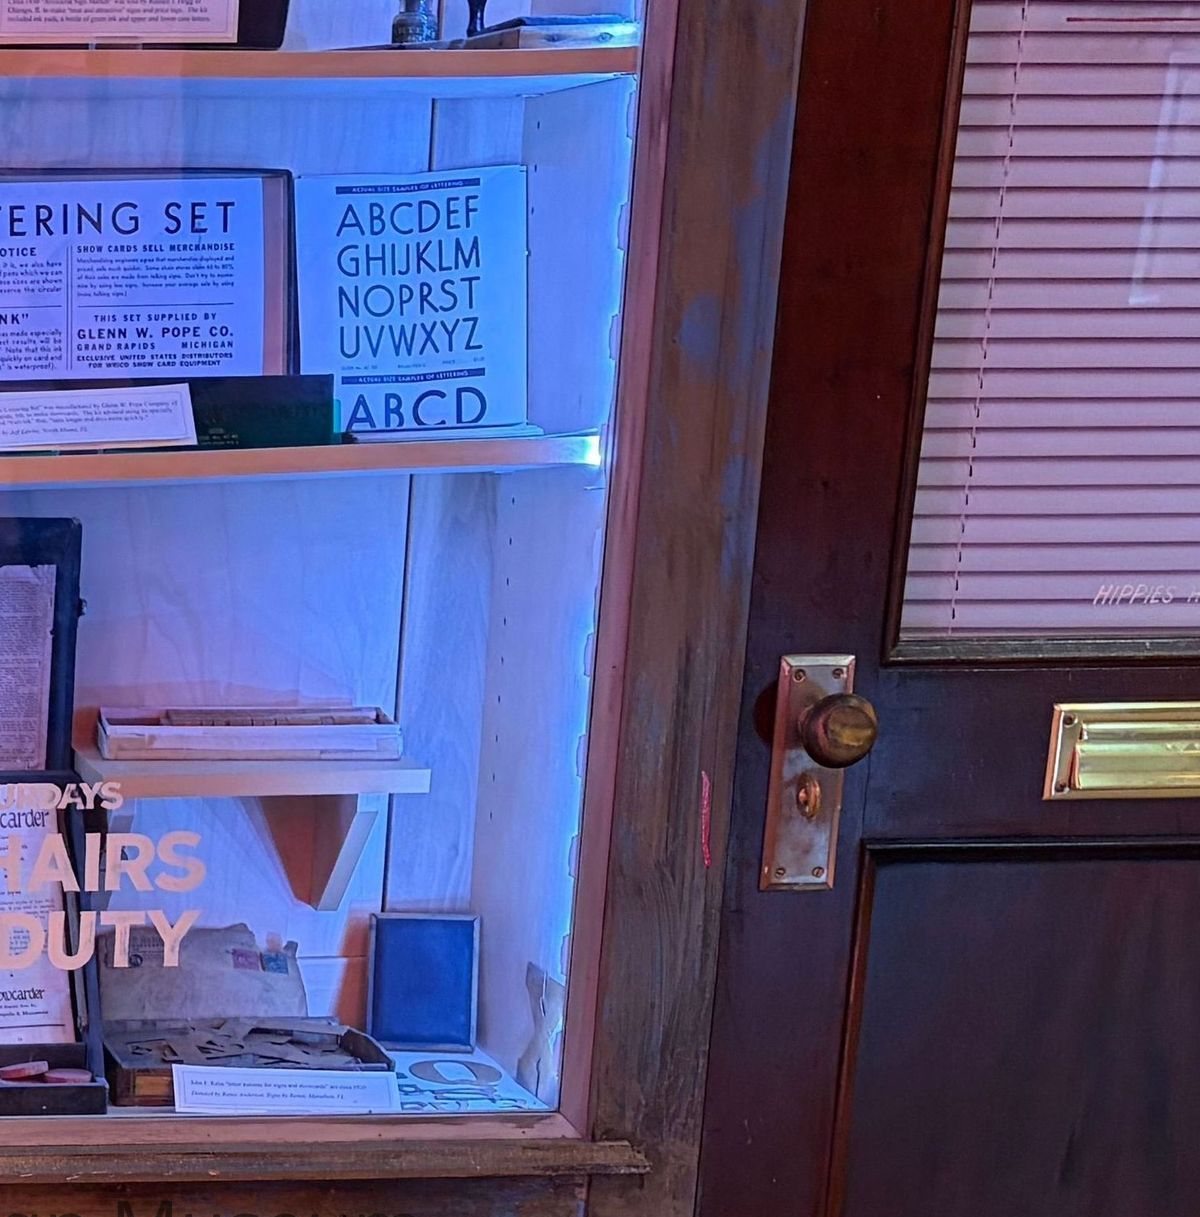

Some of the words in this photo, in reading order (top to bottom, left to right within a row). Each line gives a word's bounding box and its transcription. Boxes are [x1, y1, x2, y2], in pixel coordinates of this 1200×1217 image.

[164, 201, 235, 235] SET
[336, 195, 479, 237] ABCDEF
[76, 245, 103, 253] SHOW
[142, 244, 165, 252] SELL
[169, 243, 235, 252] MERCHANDISE
[338, 276, 481, 318] NOPRST
[94, 314, 117, 322] THIS
[123, 314, 141, 322] SET
[147, 313, 198, 321] SUPPLIED
[77, 328, 127, 339] GLENN
[135, 328, 153, 338] W.
[161, 326, 200, 338] POPE
[209, 326, 234, 337] CO.
[340, 317, 483, 359] UVWXYZ
[77, 343, 112, 351] GRAND
[181, 352, 233, 360] DISTRIBUTORS
[346, 386, 488, 431] ABCD
[1092, 583, 1177, 606] HIPPIES
